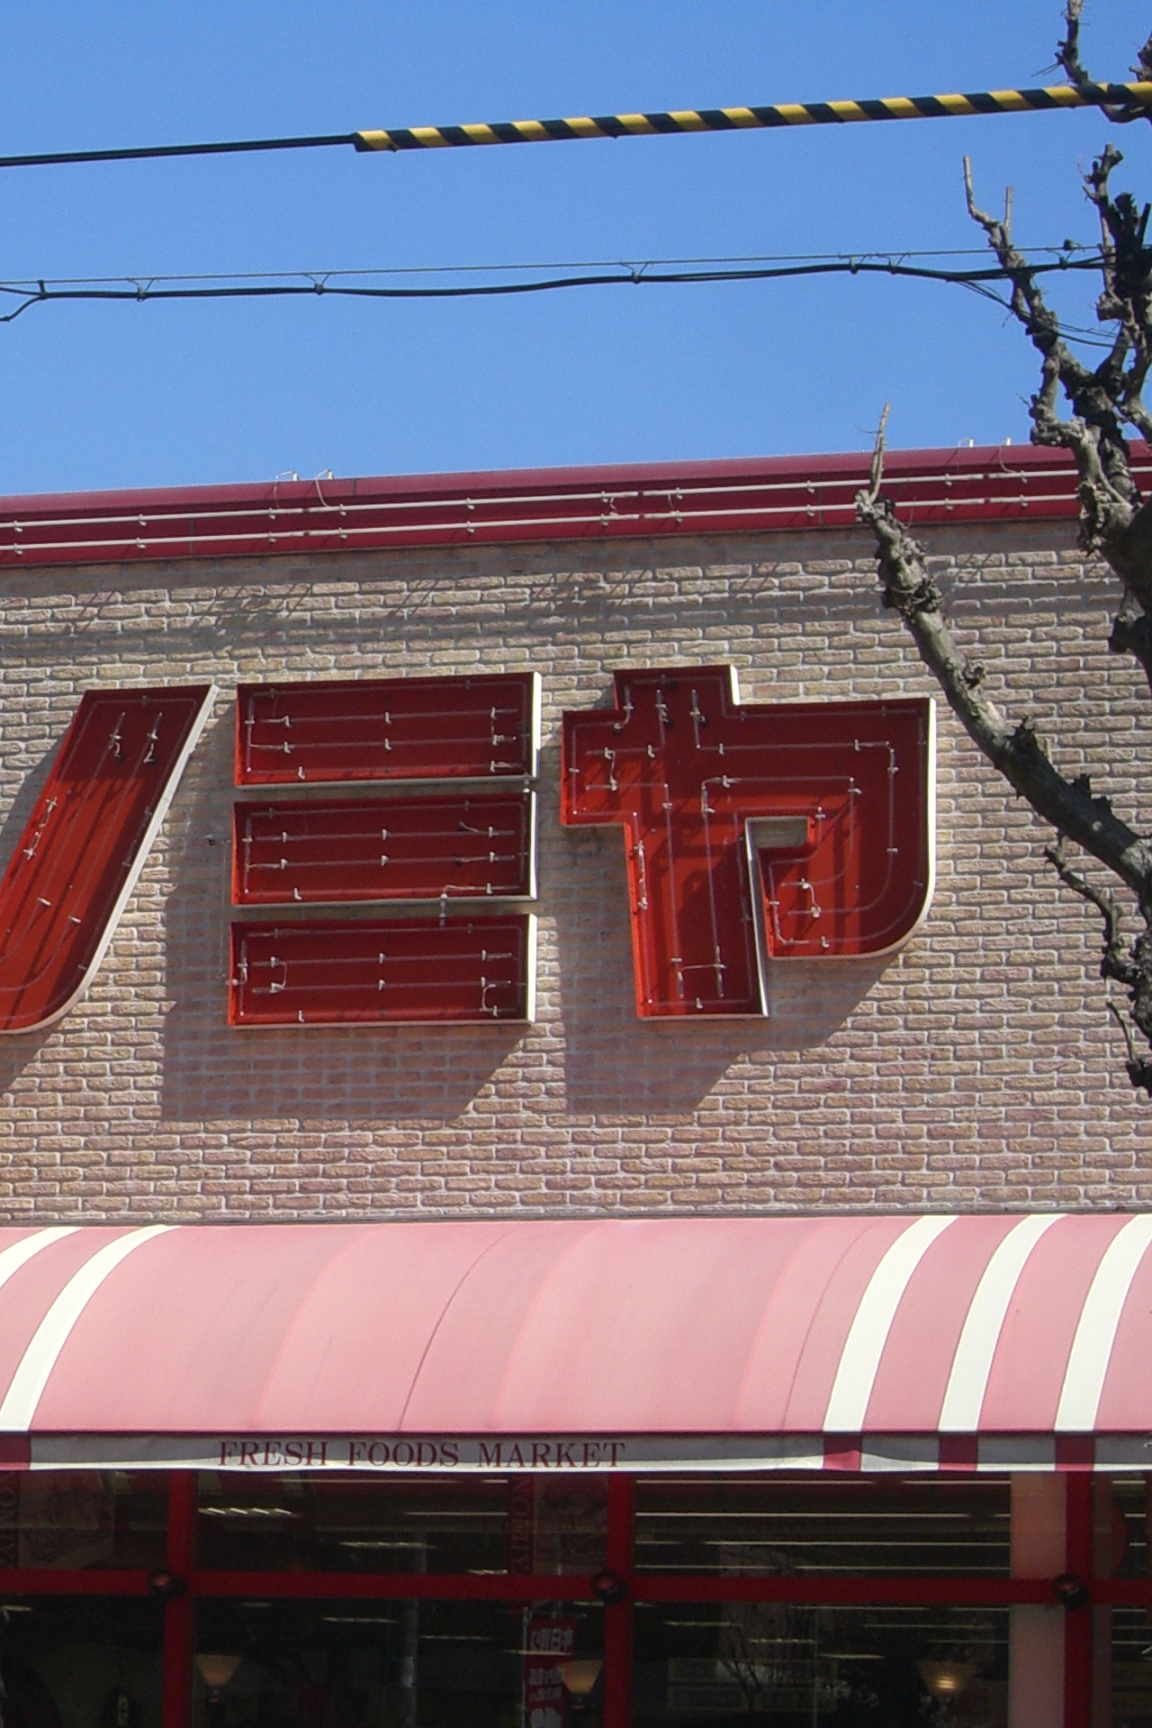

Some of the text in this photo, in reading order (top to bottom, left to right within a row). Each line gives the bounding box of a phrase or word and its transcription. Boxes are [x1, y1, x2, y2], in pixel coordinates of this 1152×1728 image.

[219, 1441, 626, 1469] FRESH FOODS MARKET
